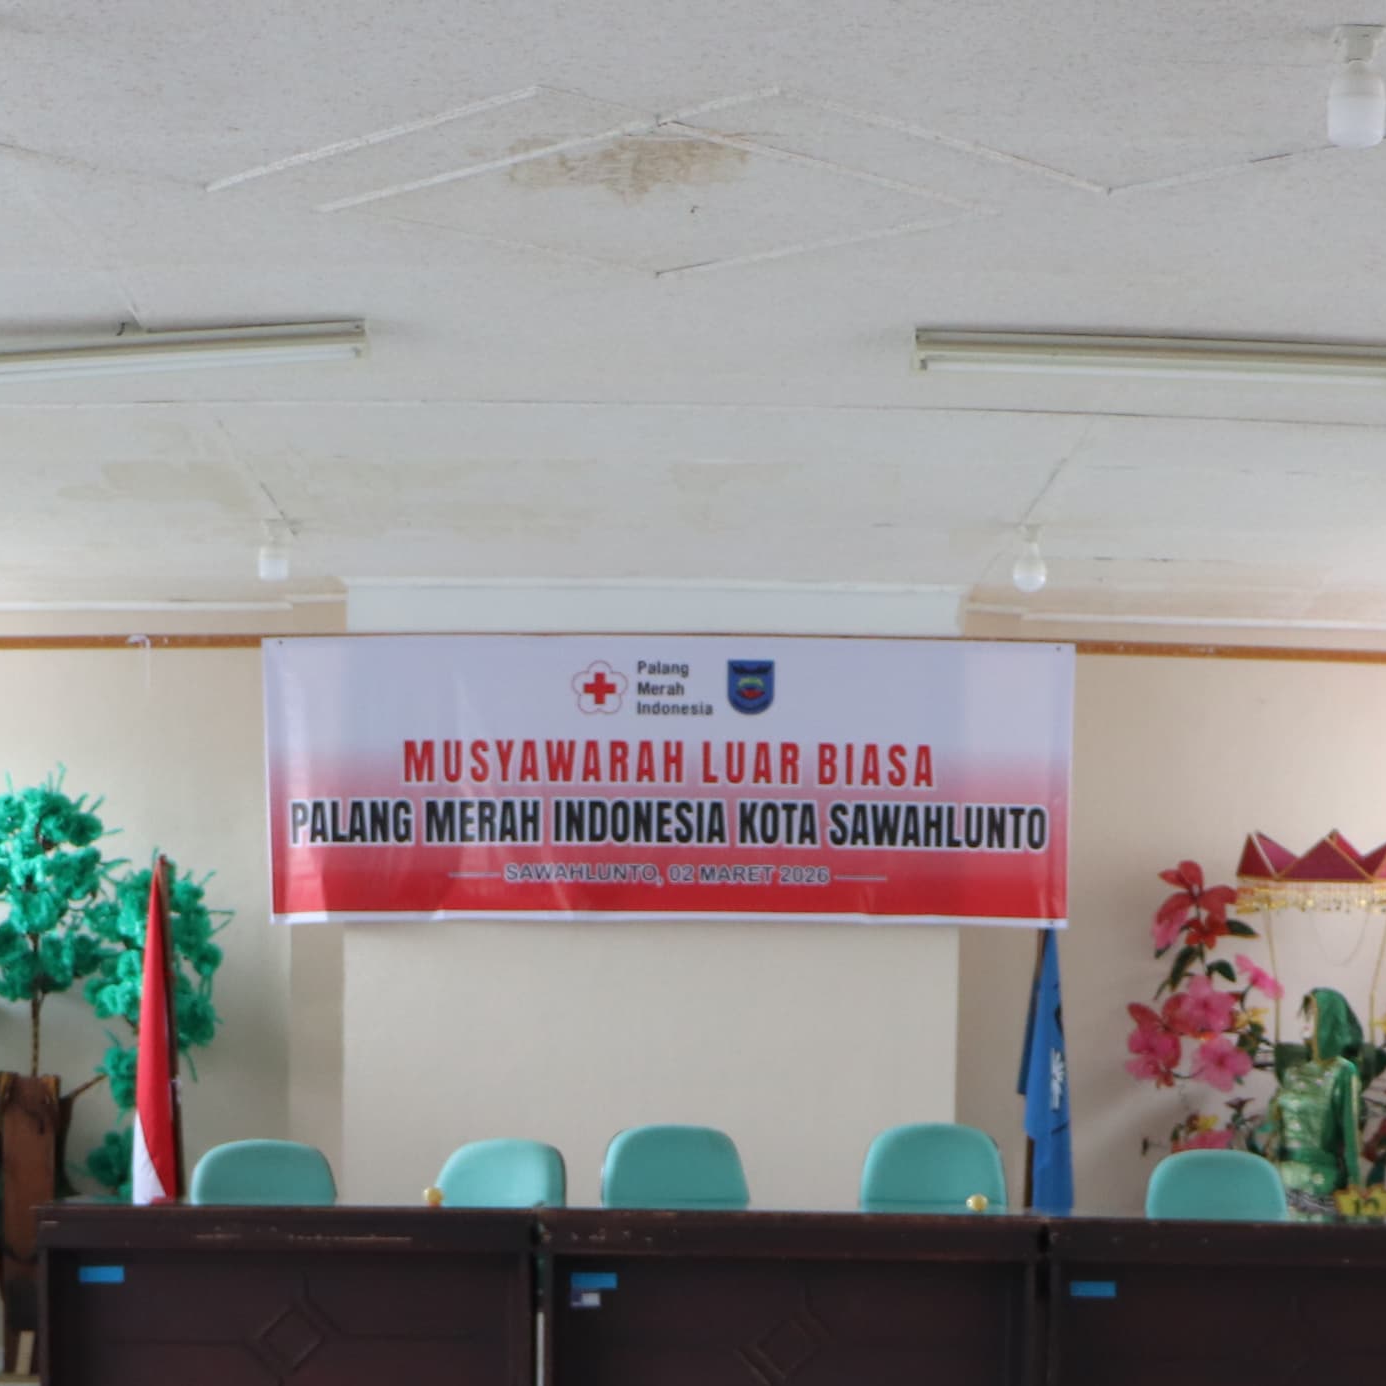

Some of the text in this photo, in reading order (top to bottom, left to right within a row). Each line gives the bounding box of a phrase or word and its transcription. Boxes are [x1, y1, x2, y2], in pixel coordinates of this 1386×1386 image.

[637, 661, 689, 676] Palang
[637, 682, 684, 695] Merah
[637, 702, 713, 715] Indonesia
[403, 739, 934, 787] MUSYAWARAH LUAR BIASA
[291, 800, 1047, 850] PALANG MERAH INDONESIA KOTA SAWAHLUNTO
[505, 863, 830, 886] SAWAHLUNTO, 02 MARET 2026
